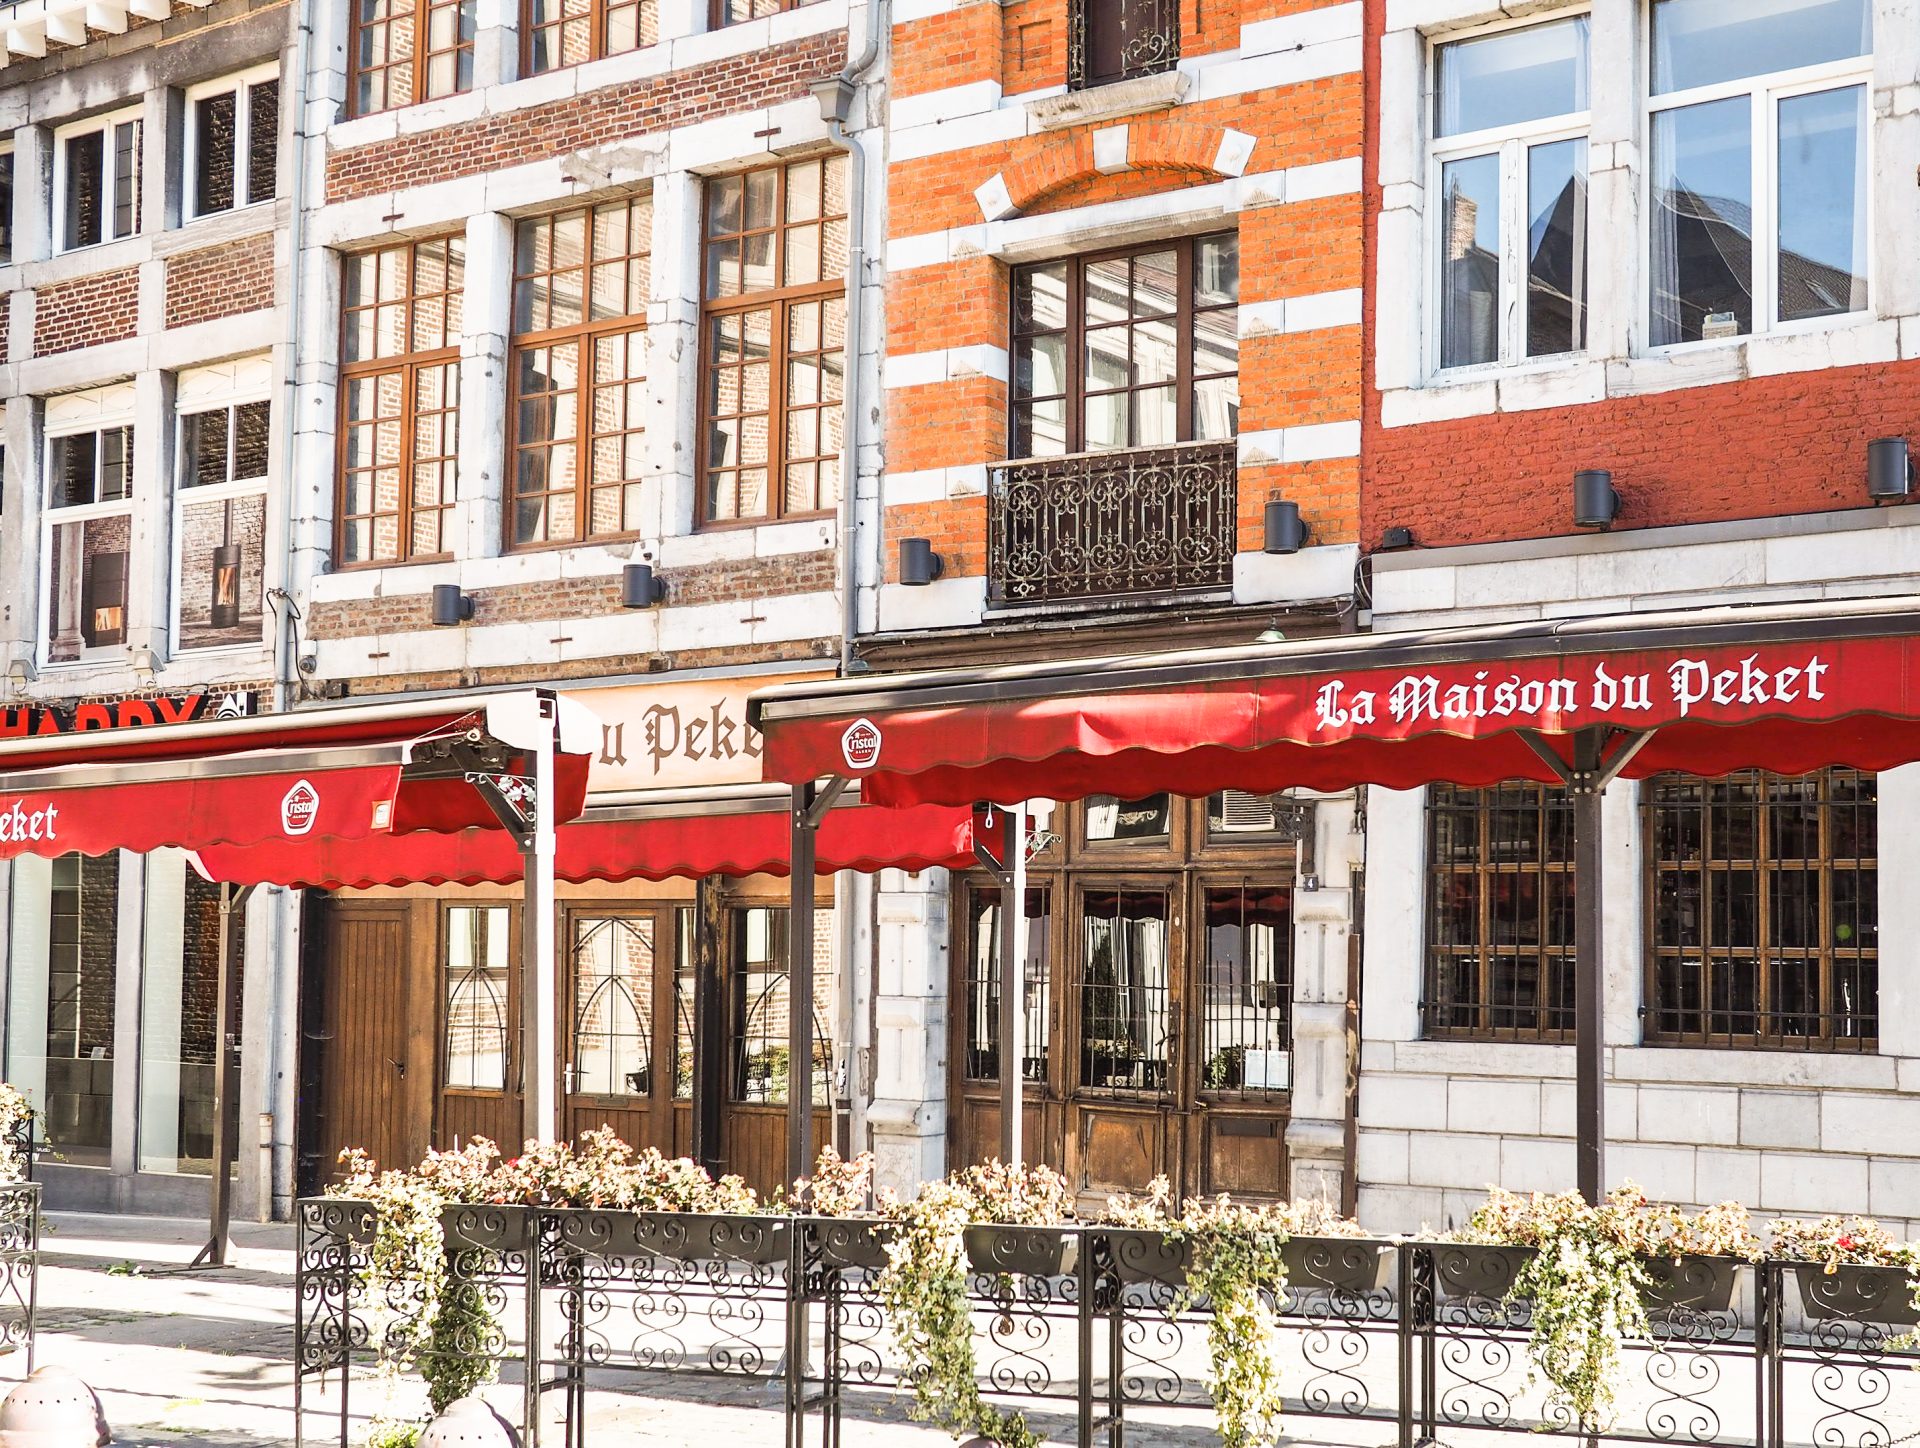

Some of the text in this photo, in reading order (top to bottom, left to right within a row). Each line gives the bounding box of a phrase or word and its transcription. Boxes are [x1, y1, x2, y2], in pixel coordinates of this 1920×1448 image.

[1315, 652, 1830, 732] La Maison du Peket
[598, 696, 764, 776] u Peke
[847, 735, 877, 752] Cristal
[0, 798, 59, 842] eket
[287, 799, 313, 817] Cristal
[1307, 878, 1314, 889] 4
